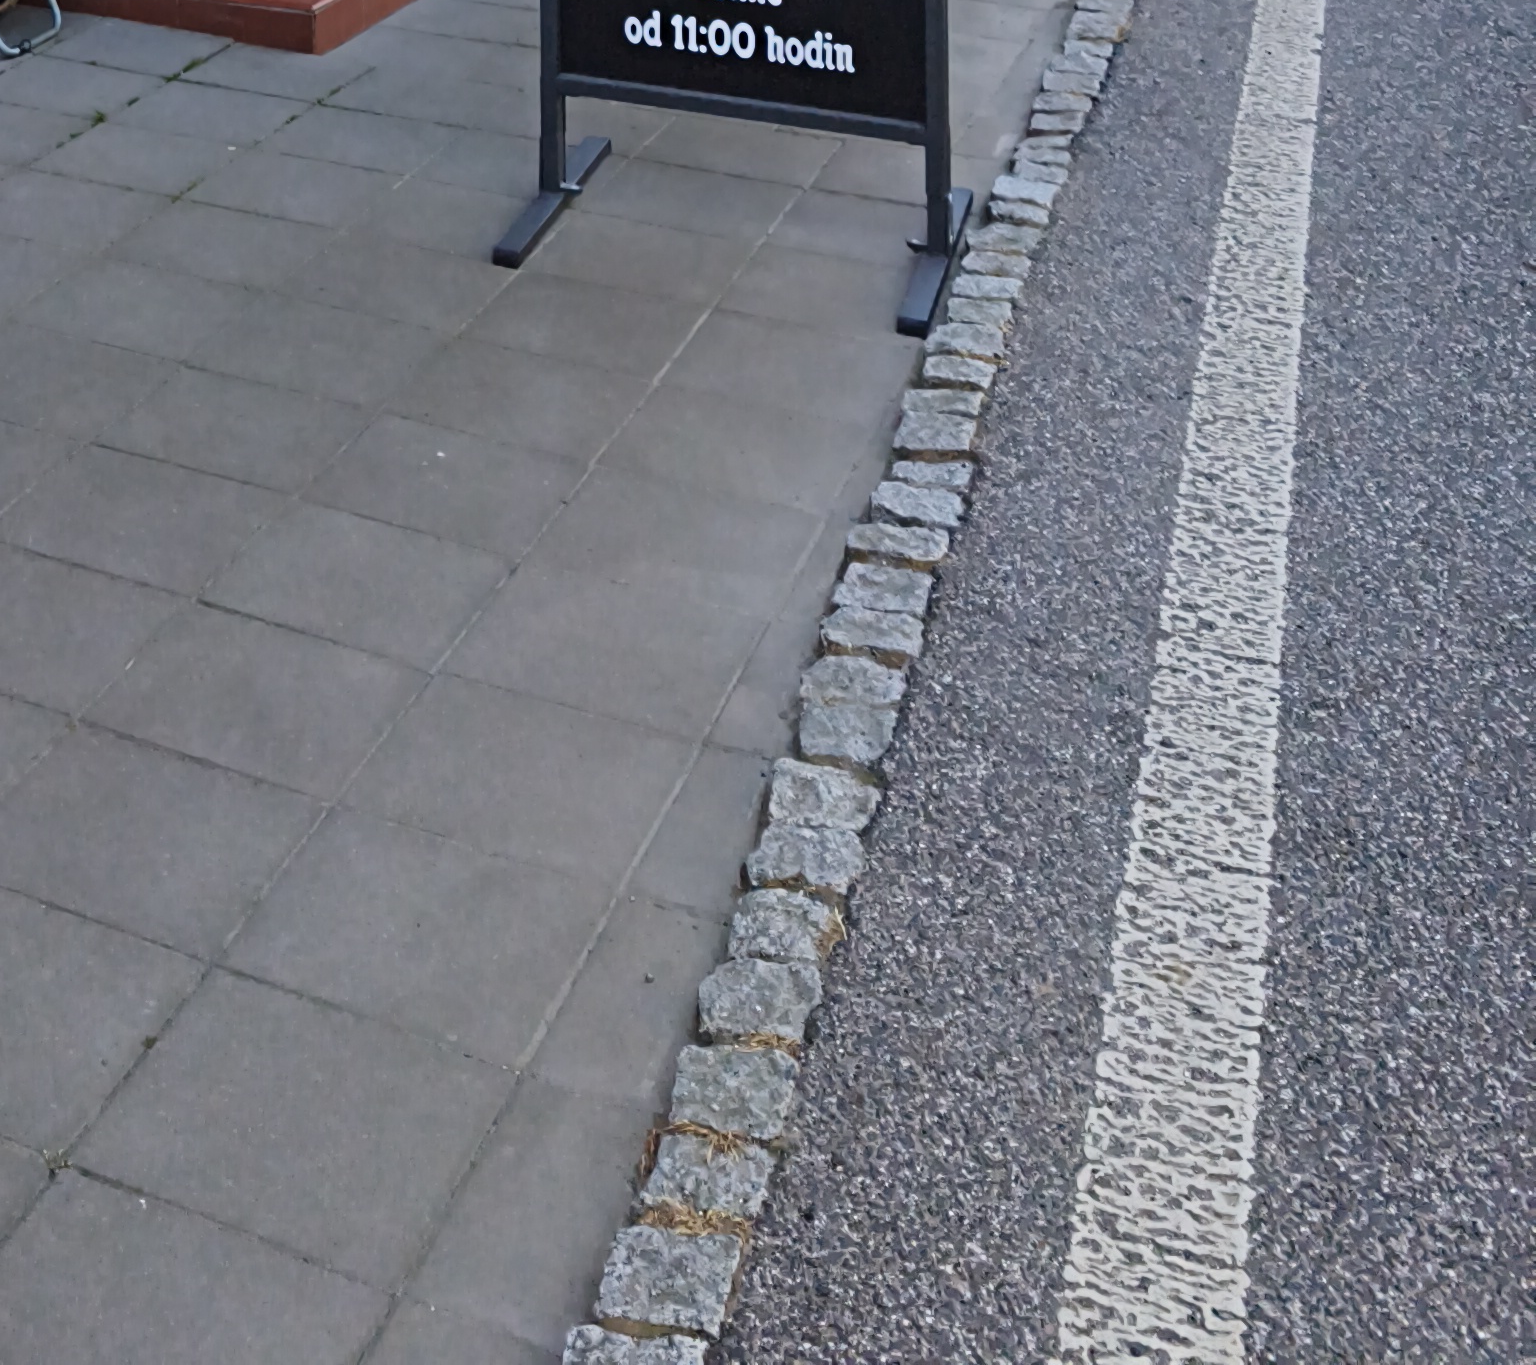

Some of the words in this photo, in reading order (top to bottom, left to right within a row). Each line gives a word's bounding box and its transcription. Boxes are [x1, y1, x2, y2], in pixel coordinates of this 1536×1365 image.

[624, 10, 662, 48] od
[670, 13, 756, 59] 11:00
[765, 25, 855, 73] hodin
